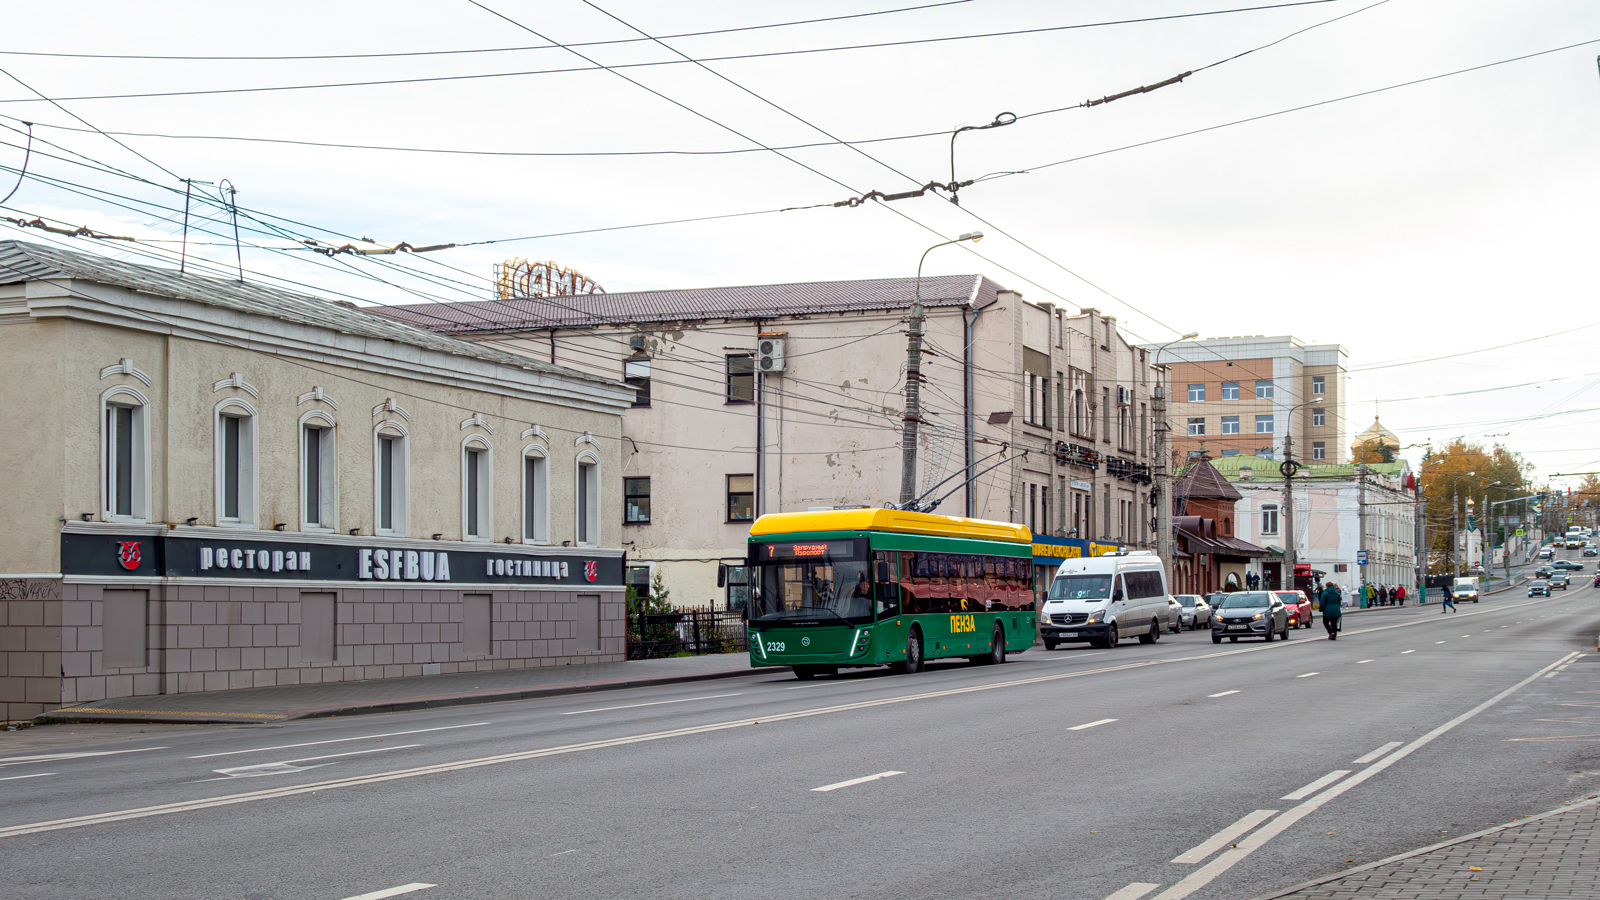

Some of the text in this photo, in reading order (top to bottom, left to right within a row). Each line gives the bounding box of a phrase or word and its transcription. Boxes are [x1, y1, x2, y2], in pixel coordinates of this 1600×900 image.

[200, 547, 311, 572] ресторан
[768, 546, 775, 557] 7
[358, 549, 450, 580] ESFBUA
[486, 559, 568, 580] гостиница
[950, 614, 976, 633] ПЕНЗА
[767, 642, 785, 651] 2329
